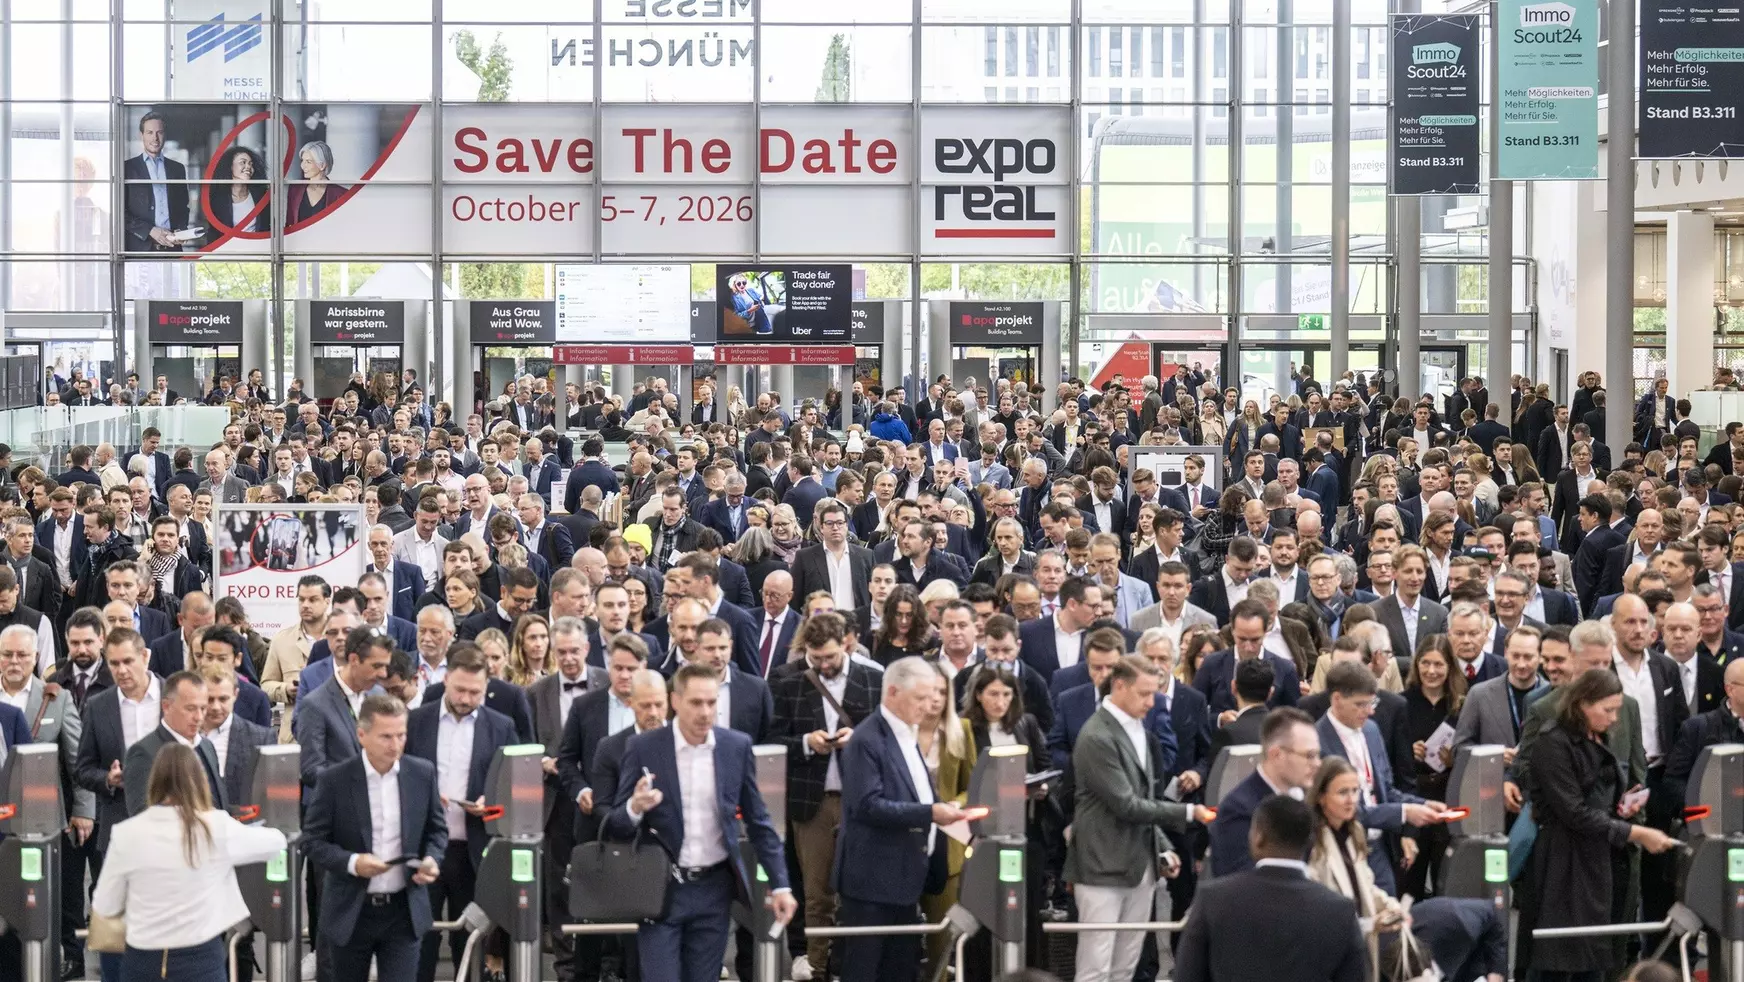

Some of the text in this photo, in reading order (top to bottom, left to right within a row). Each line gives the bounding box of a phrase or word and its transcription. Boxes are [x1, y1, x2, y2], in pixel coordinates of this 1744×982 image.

[1525, 8, 1570, 22] Immo
[1514, 28, 1582, 44] Scout24
[1417, 48, 1456, 60] Immo
[1647, 50, 1744, 61] Mehr Möglichkeite
[1407, 65, 1466, 78] Scout24
[1647, 64, 1708, 75] Mehr Erfolg.
[224, 78, 263, 87] MESSE
[1647, 77, 1710, 87] Mehr für Sie.
[224, 90, 268, 100] MÜNCH
[1504, 89, 1592, 98] Mehr Möglichkeiten.
[1528, 100, 1557, 110] Erfolg.
[1504, 112, 1558, 120] Mehr für Sie.
[1646, 106, 1735, 119] Stand B3.311
[1420, 116, 1475, 125] Möglichkeiten.
[1420, 127, 1444, 135] Erfolg.
[1504, 136, 1579, 146] Stand B3.311
[454, 127, 897, 174] Save The Date
[935, 138, 1056, 182] expo
[1400, 157, 1464, 166] Stand B3.311
[452, 195, 580, 222] October
[677, 196, 754, 222] 2026
[792, 271, 831, 280] Trade fair
[792, 280, 836, 290] day done?
[1306, 291, 1329, 303] Stand
[327, 307, 385, 317] Abrissbirne
[492, 307, 540, 317] Aus Grau
[169, 315, 230, 326] apoprojekt
[346, 320, 388, 330] gestern.
[490, 319, 542, 328] wird Wow.
[973, 314, 1032, 327] apoprojekt
[792, 327, 812, 335] Uber
[228, 585, 300, 599] EXPO RE
